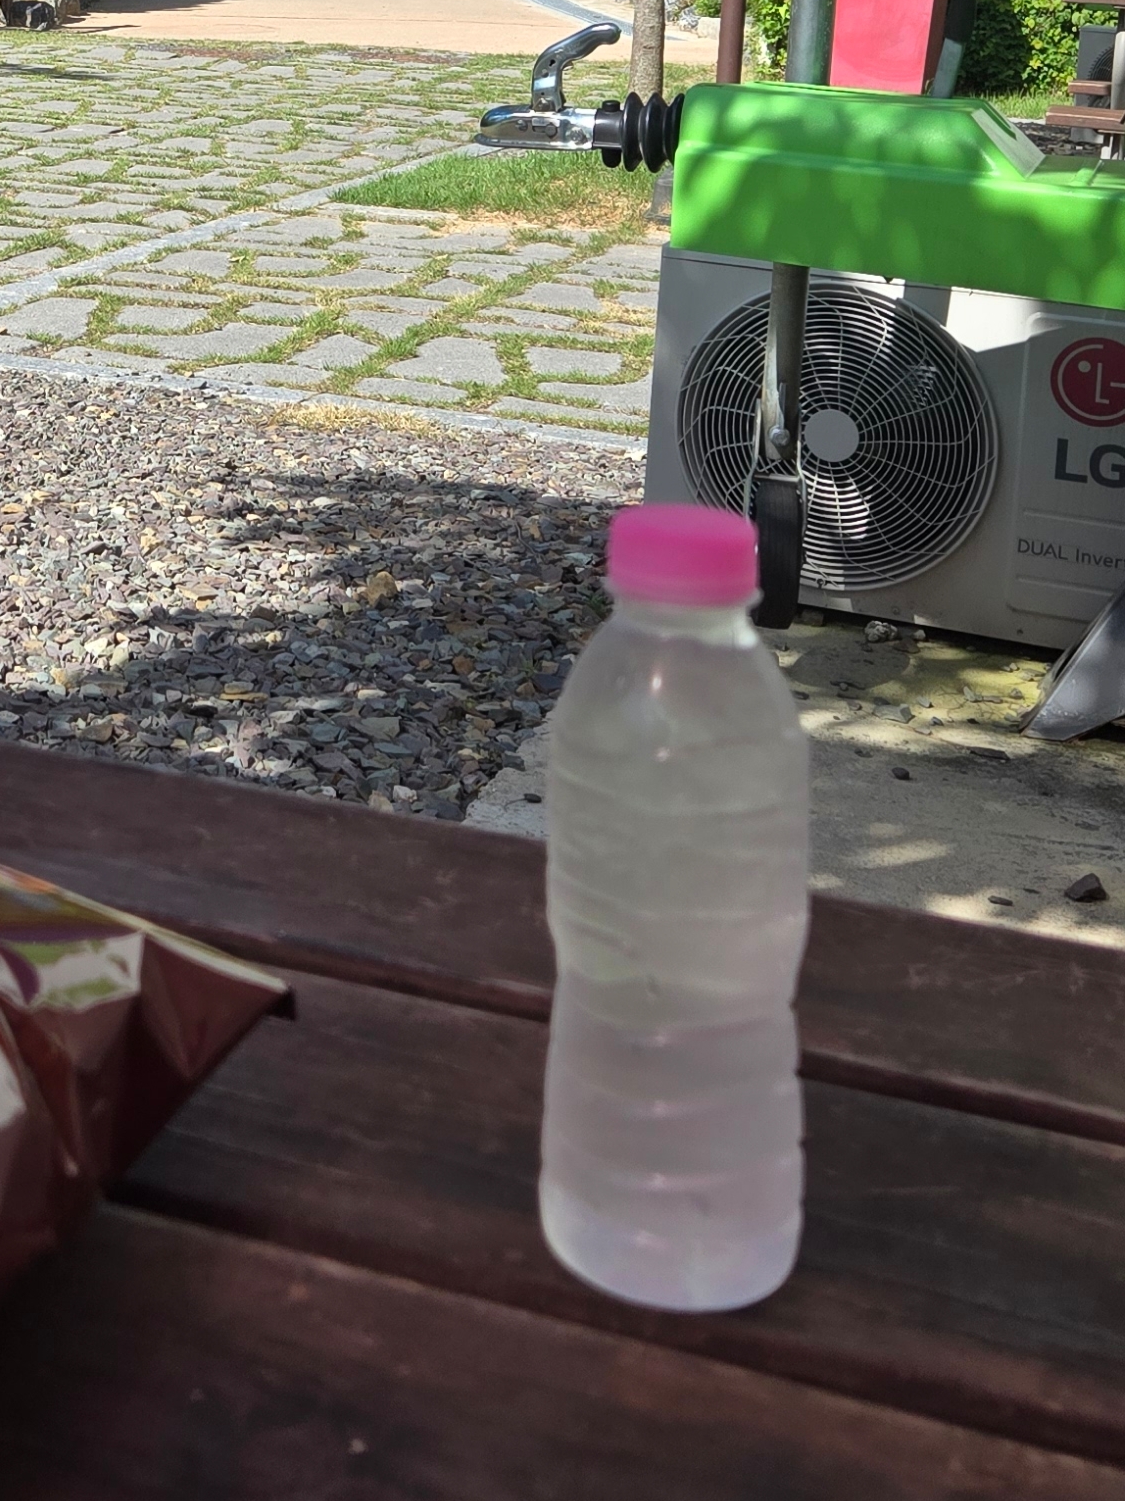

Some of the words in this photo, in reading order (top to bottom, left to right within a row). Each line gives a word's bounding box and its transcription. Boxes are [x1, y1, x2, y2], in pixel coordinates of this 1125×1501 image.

[1054, 437, 1125, 489] LG
[1017, 538, 1068, 561] DUAL
[1075, 547, 1125, 569] Inver
